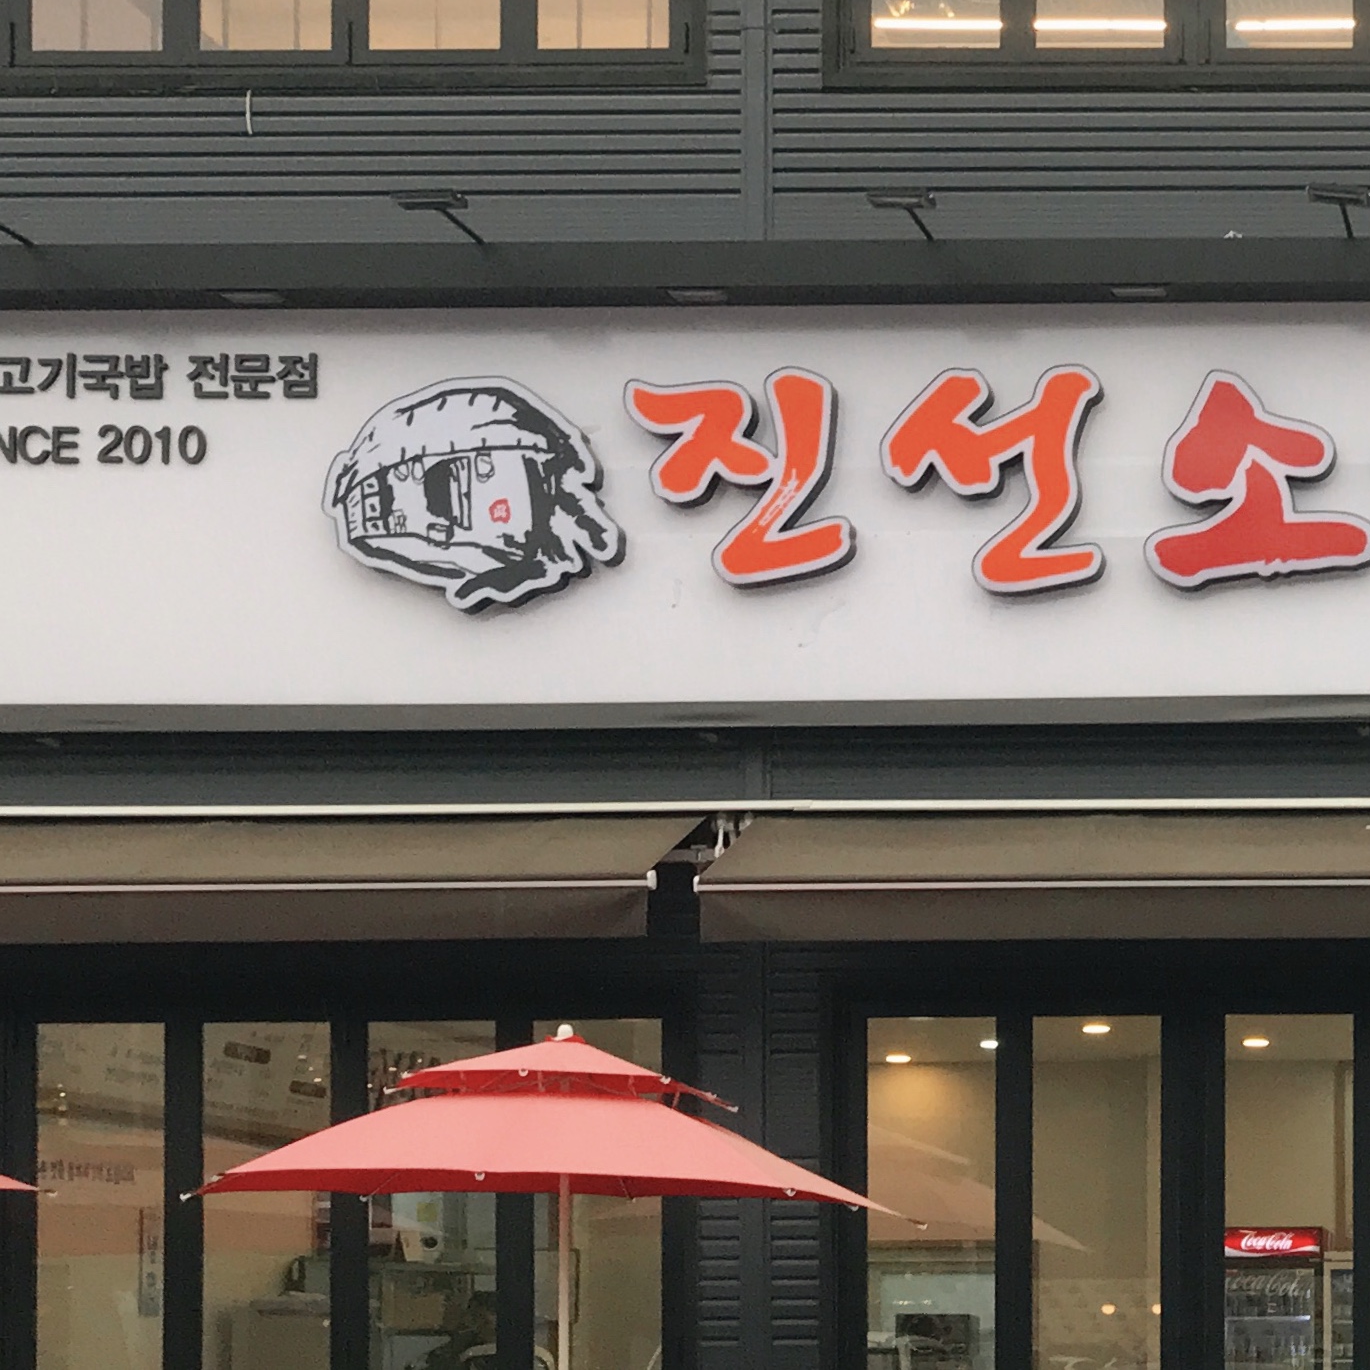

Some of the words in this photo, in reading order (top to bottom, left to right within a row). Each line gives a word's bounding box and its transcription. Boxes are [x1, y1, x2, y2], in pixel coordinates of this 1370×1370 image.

[0, 353, 168, 400] 고기국밥
[187, 353, 318, 399] 전문점
[97, 425, 207, 465] 2010
[624, 365, 1104, 594] 진선
